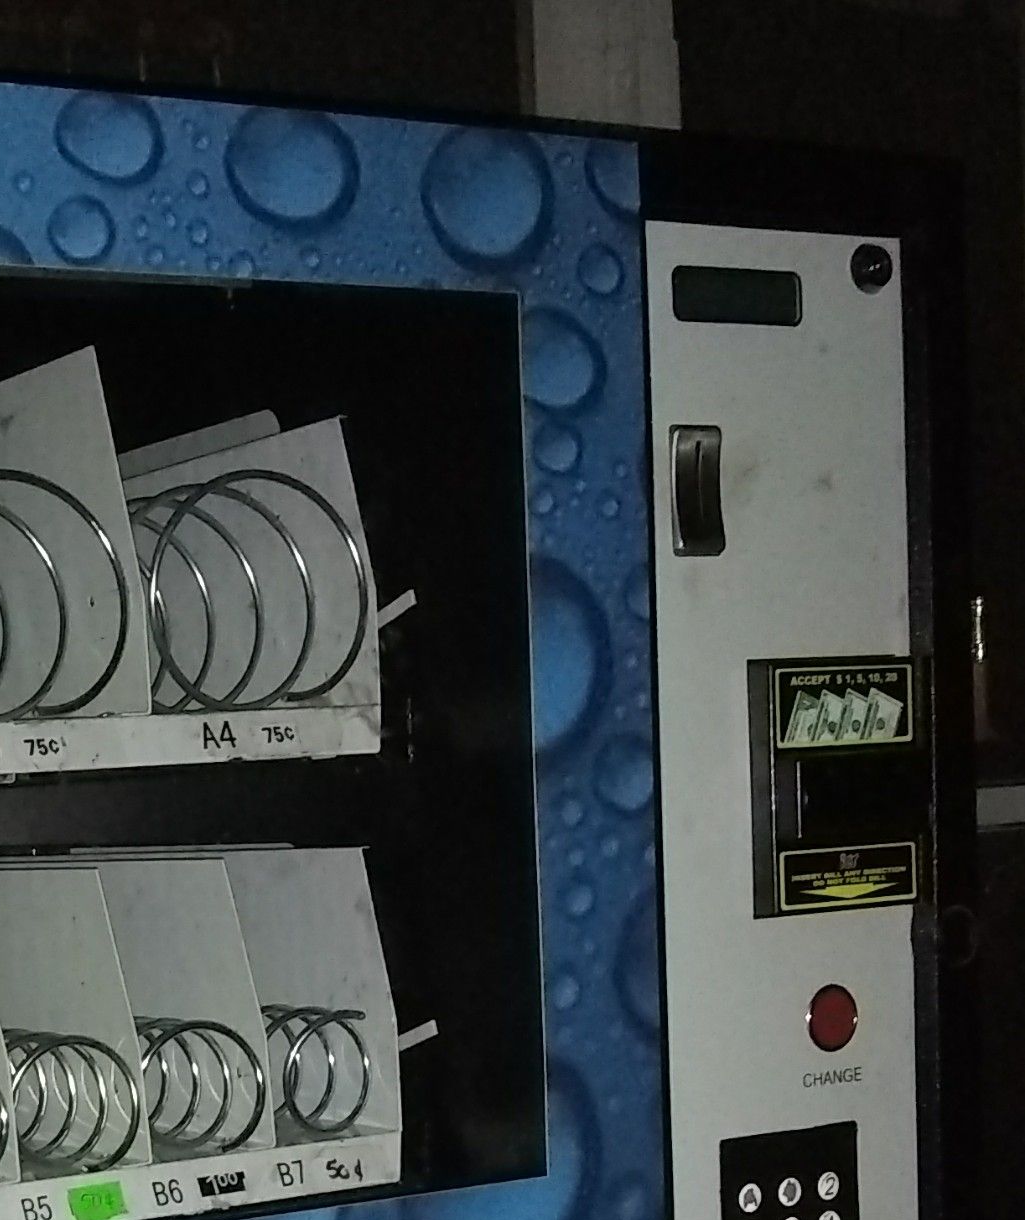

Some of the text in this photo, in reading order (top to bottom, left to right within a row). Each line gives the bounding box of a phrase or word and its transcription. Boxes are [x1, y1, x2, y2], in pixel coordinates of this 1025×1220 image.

[790, 675, 831, 687] ACCEPT
[202, 720, 238, 750] A4
[802, 1066, 863, 1088] CHANGE
[276, 1159, 306, 1187] B7
[151, 1178, 184, 1207] B6
[824, 1176, 836, 1196] 2
